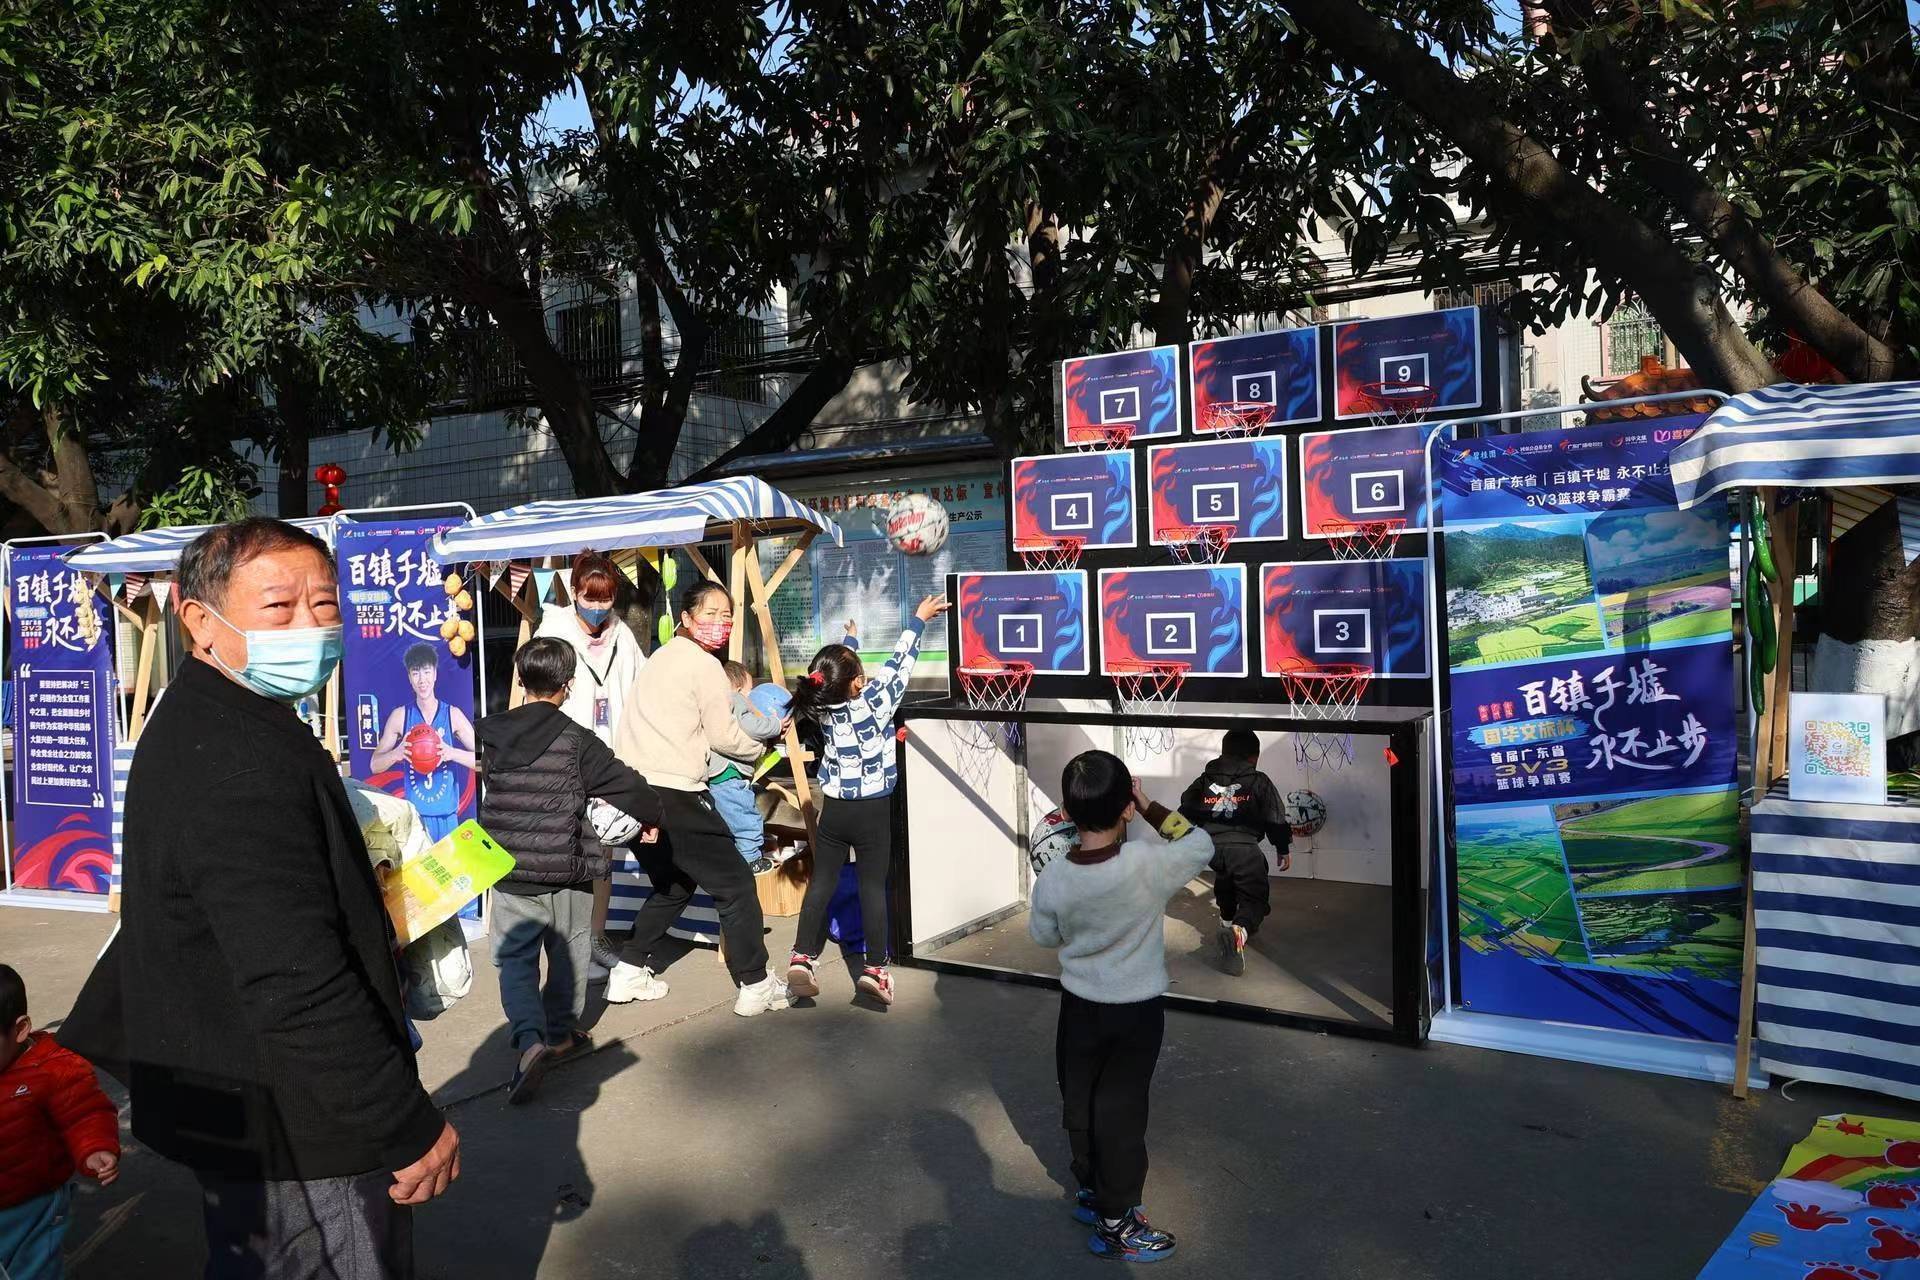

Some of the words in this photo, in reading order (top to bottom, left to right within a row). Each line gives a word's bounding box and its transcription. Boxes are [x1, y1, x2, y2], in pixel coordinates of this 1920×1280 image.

[1398, 365, 1411, 382] 9
[1249, 382, 1261, 399] 8
[1115, 398, 1125, 414] 7
[1371, 482, 1385, 501] 6
[1526, 487, 1631, 507] 3V3篮球争霸赛
[1066, 503, 1078, 520] 4
[1210, 494, 1222, 512] 5
[346, 548, 443, 600] 百镇千墟
[1015, 624, 1025, 642] 1
[1164, 625, 1178, 643] 2
[1335, 622, 1350, 641] 3
[1518, 658, 1681, 732] 百镇千墟
[1585, 712, 1707, 770] 永不止步
[1490, 745, 1565, 764] 首届广东省
[1495, 759, 1569, 777] 3V3
[1496, 771, 1571, 790] 篮球争霸赛
